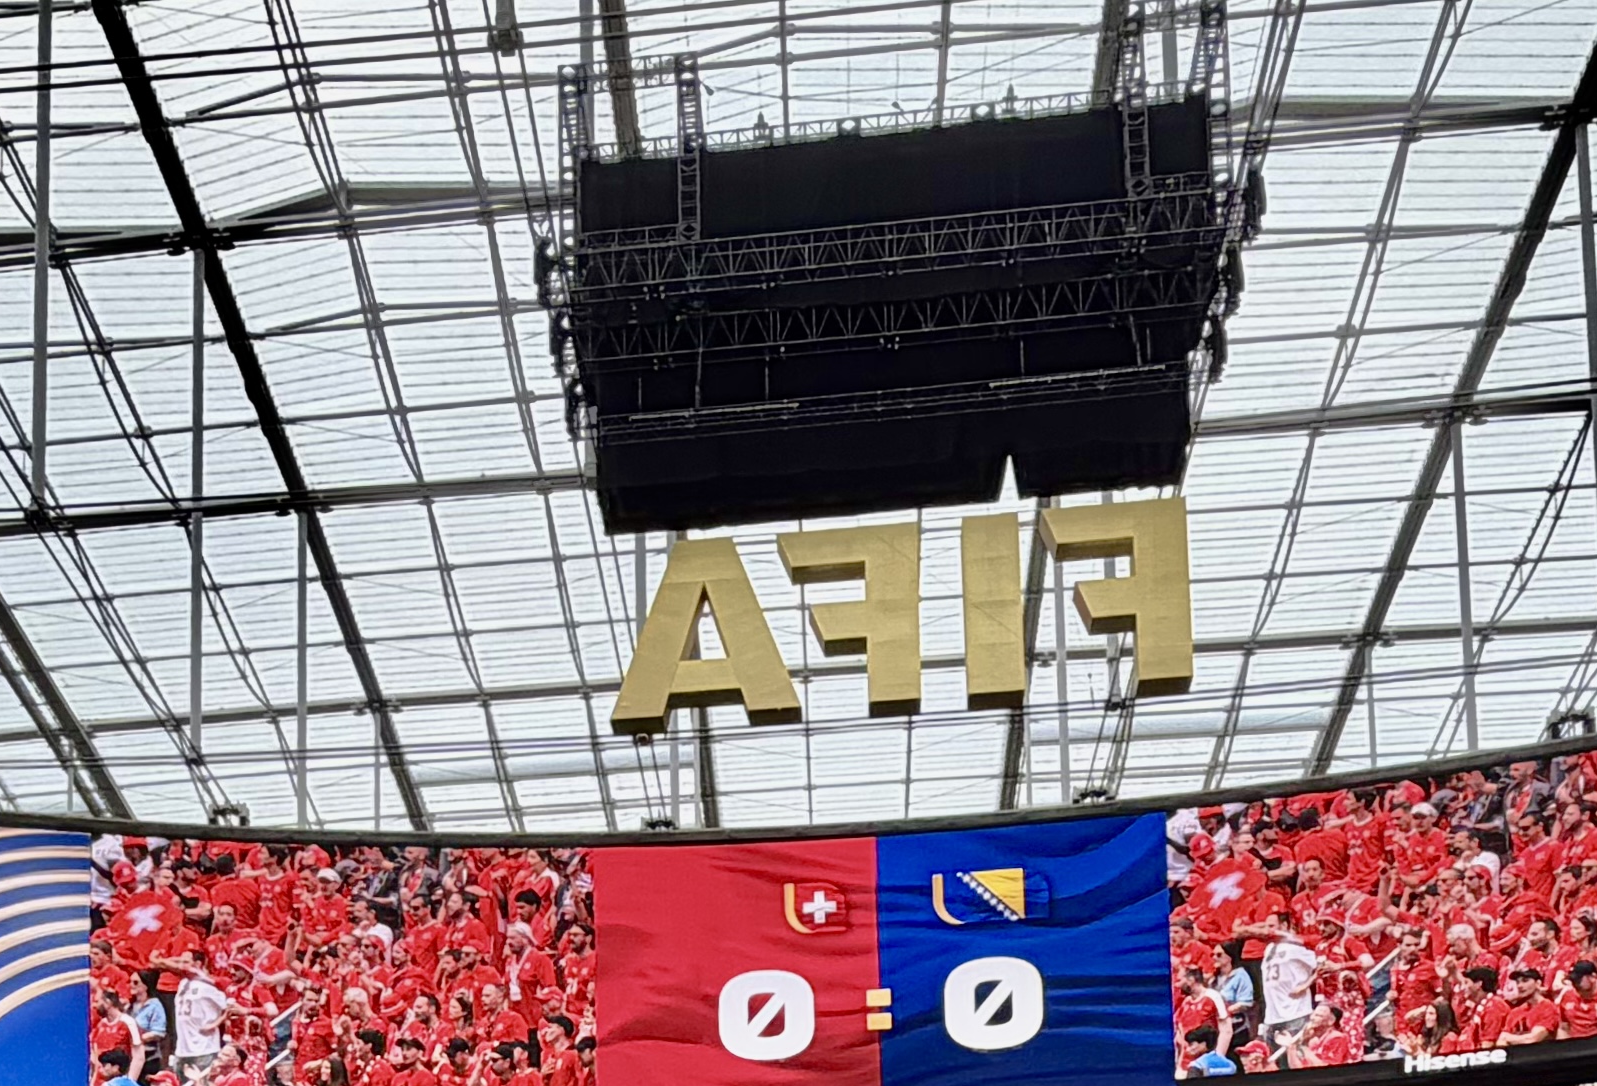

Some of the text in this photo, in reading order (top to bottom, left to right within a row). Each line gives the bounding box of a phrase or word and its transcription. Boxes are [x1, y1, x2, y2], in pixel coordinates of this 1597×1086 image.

[718, 969, 816, 1061] 0
[943, 956, 1044, 1051] 0
[1404, 1048, 1507, 1074] Hisense
